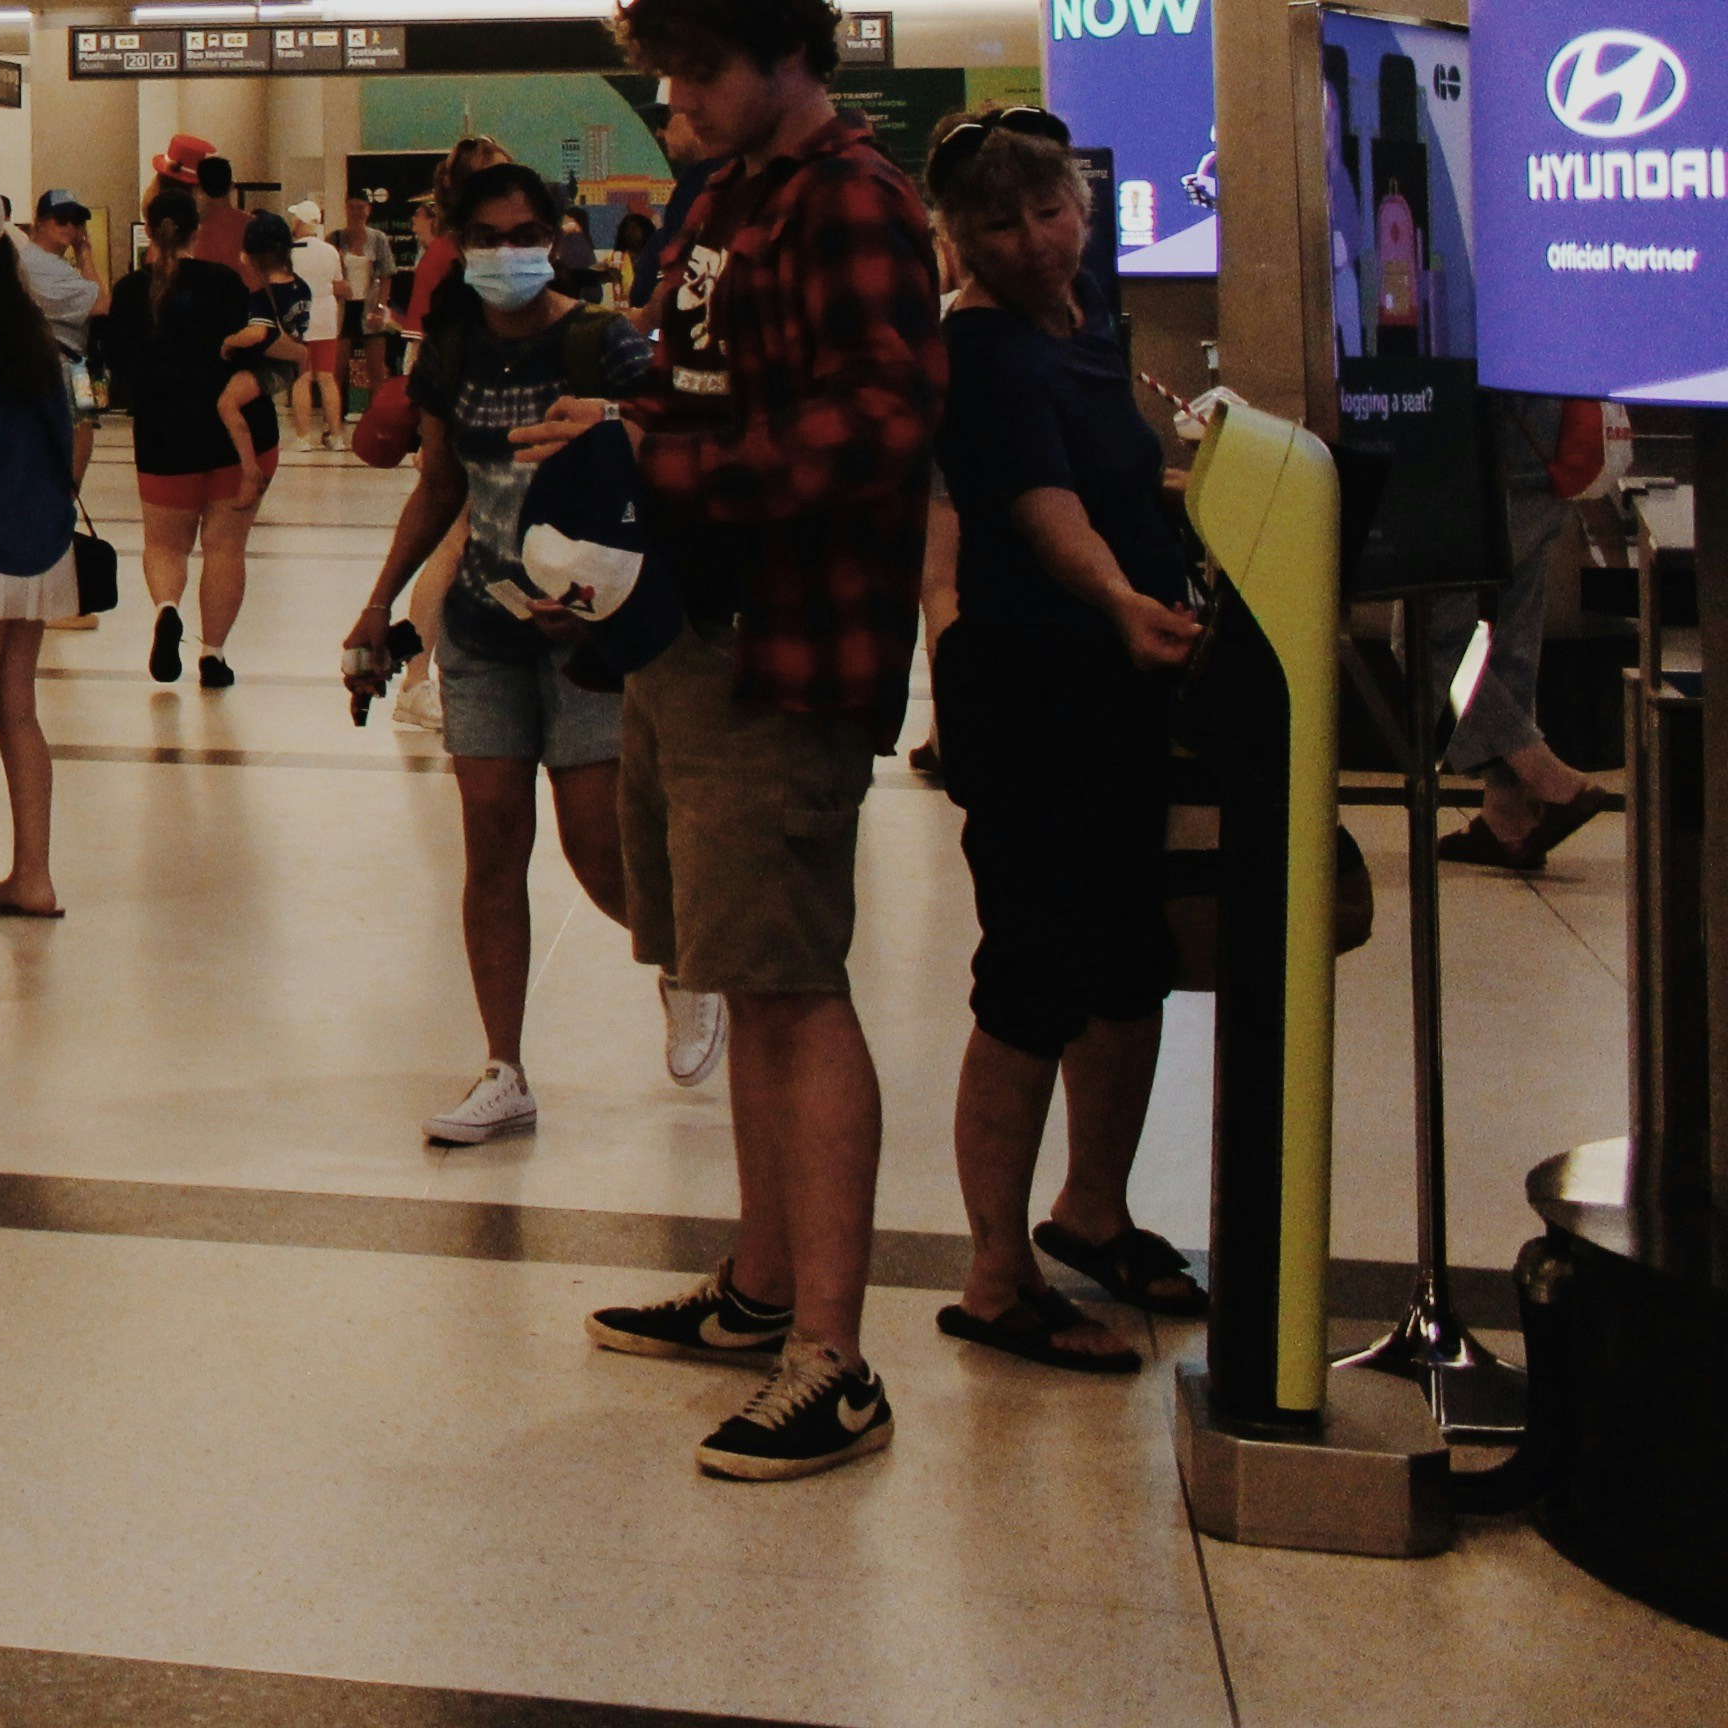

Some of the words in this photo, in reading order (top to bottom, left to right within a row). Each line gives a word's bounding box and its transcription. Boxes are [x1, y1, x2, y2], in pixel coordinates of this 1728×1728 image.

[128, 55, 145, 68] 20
[156, 55, 173, 68] 21
[1528, 148, 1726, 201] HYUNDAI
[1547, 242, 1609, 272] Official
[1612, 242, 1698, 271] Partner
[1392, 393, 1399, 412] a
[1402, 386, 1434, 412] seat?
